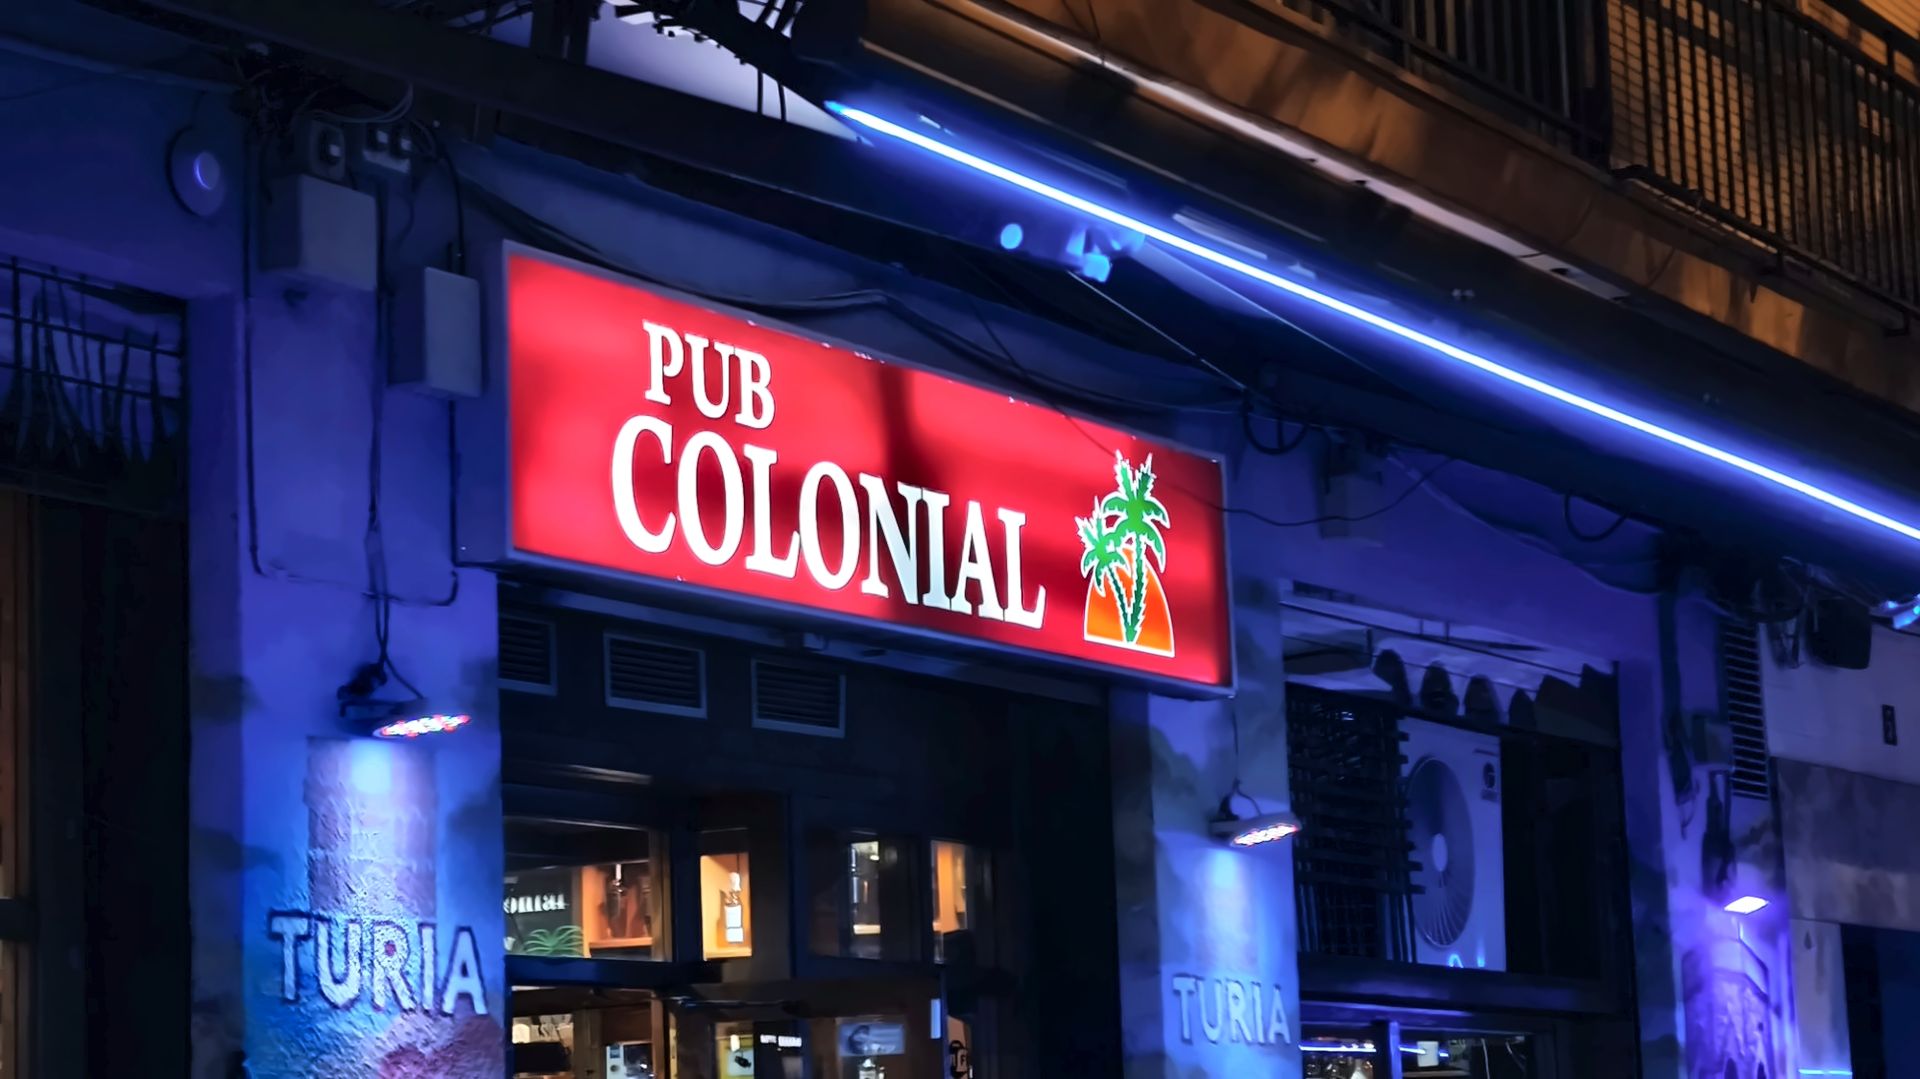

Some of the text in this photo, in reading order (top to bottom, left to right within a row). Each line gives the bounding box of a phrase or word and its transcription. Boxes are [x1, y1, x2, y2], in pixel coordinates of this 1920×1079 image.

[642, 319, 775, 430] PUB
[611, 413, 1047, 630] COLONIAL
[268, 909, 489, 1017] TURIA
[1172, 973, 1291, 1046] TURIA
